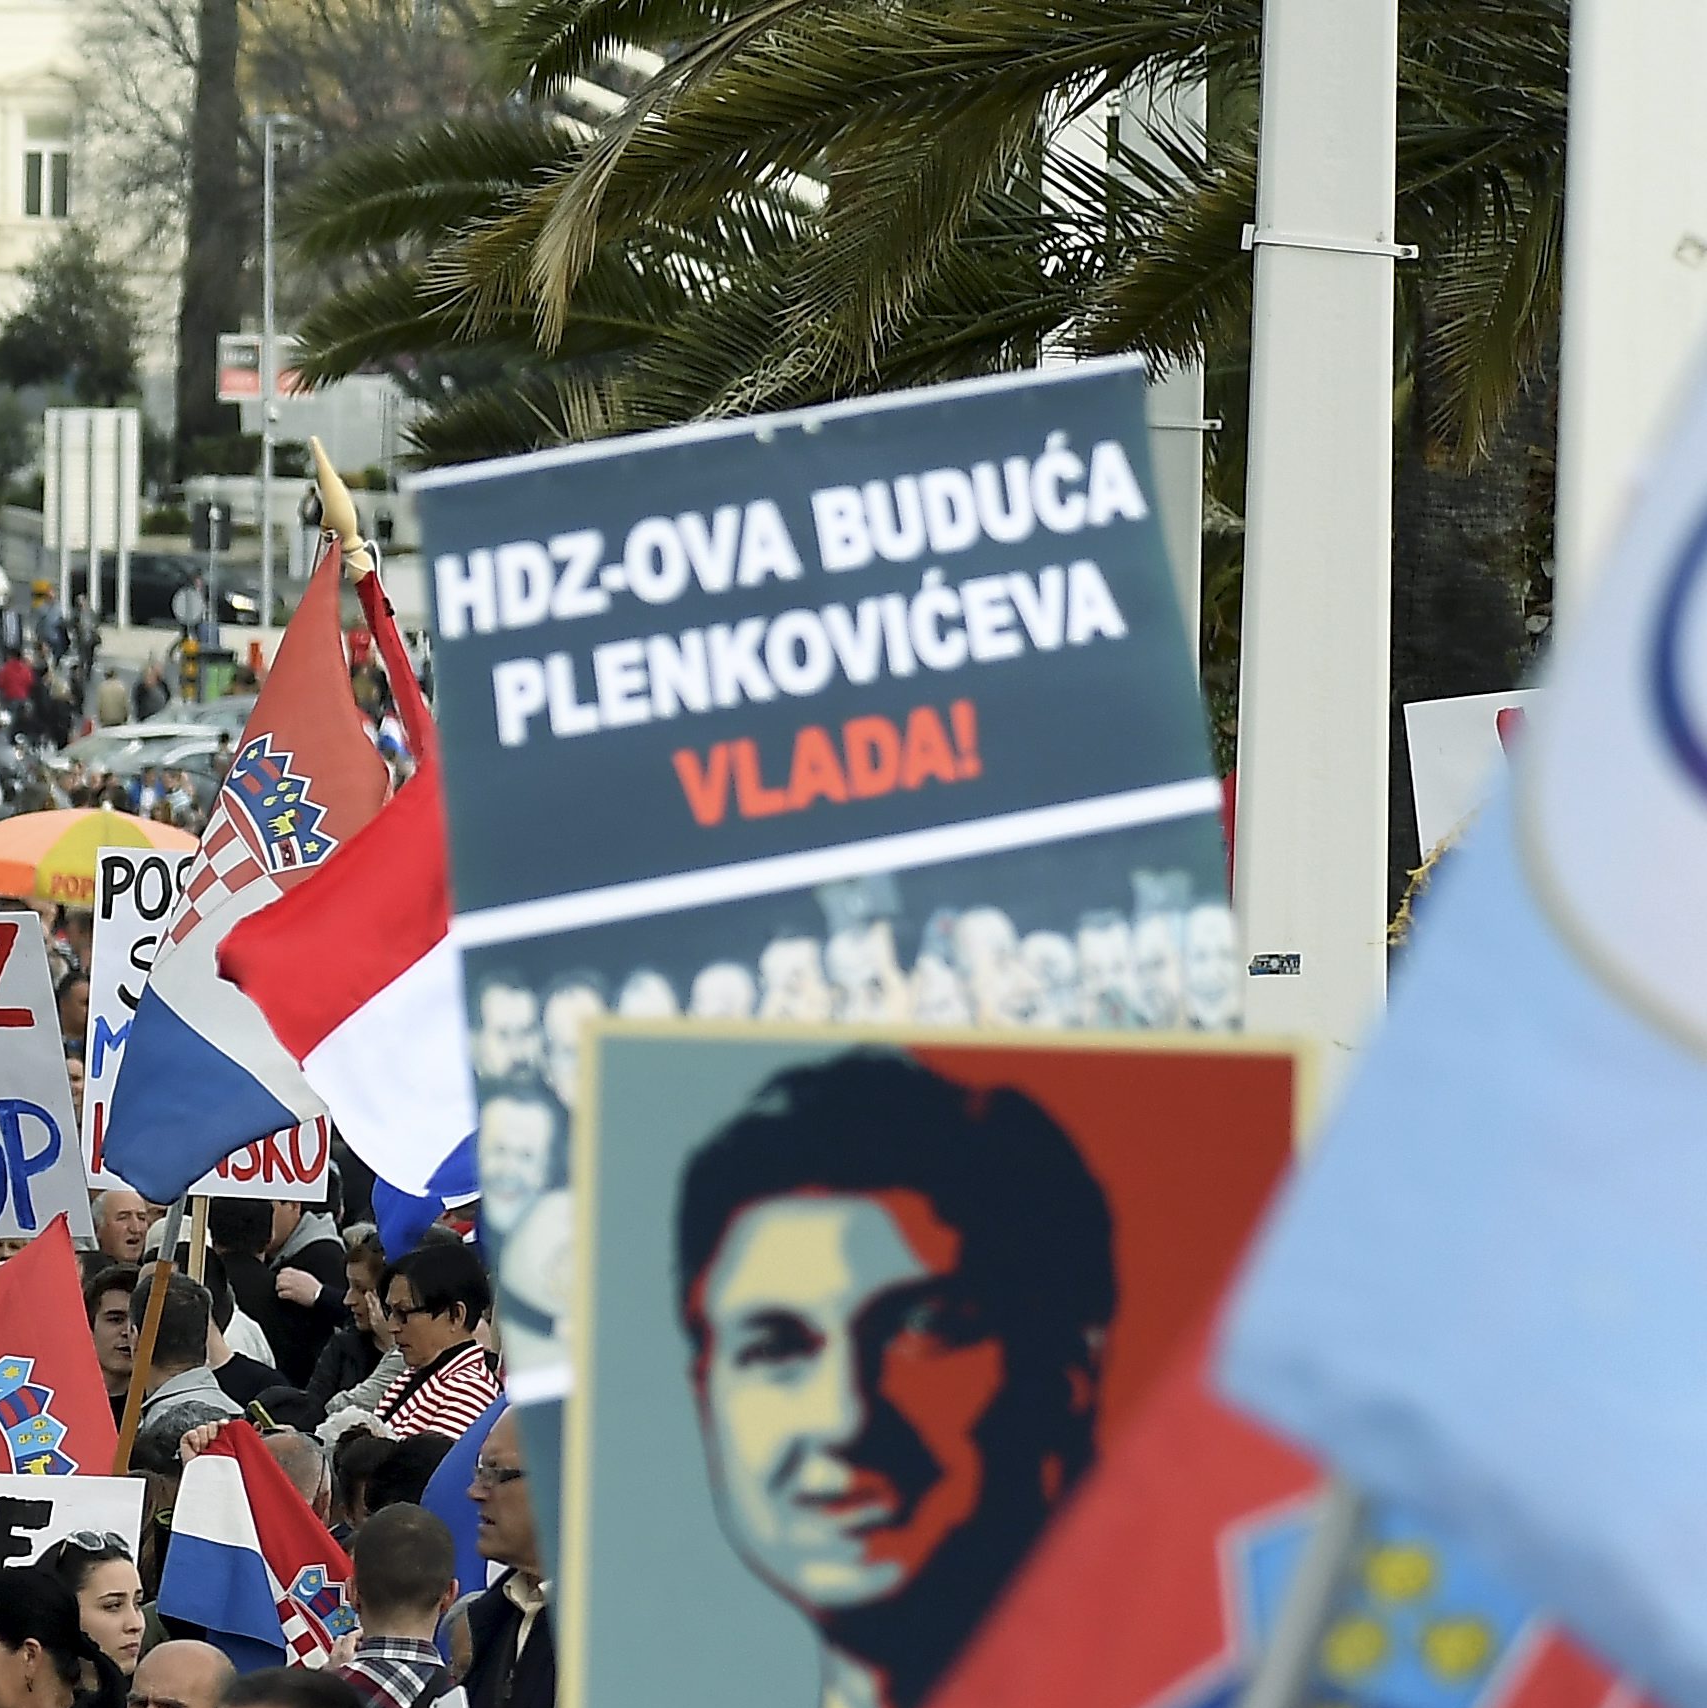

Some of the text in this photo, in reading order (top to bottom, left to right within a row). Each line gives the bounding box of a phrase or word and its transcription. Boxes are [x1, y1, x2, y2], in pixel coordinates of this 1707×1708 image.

[432, 431, 1149, 640] HDZ-OVA BUDUĆA
[492, 557, 1130, 748] PLENKOVIĆEVA
[673, 698, 984, 828] VLADA!
